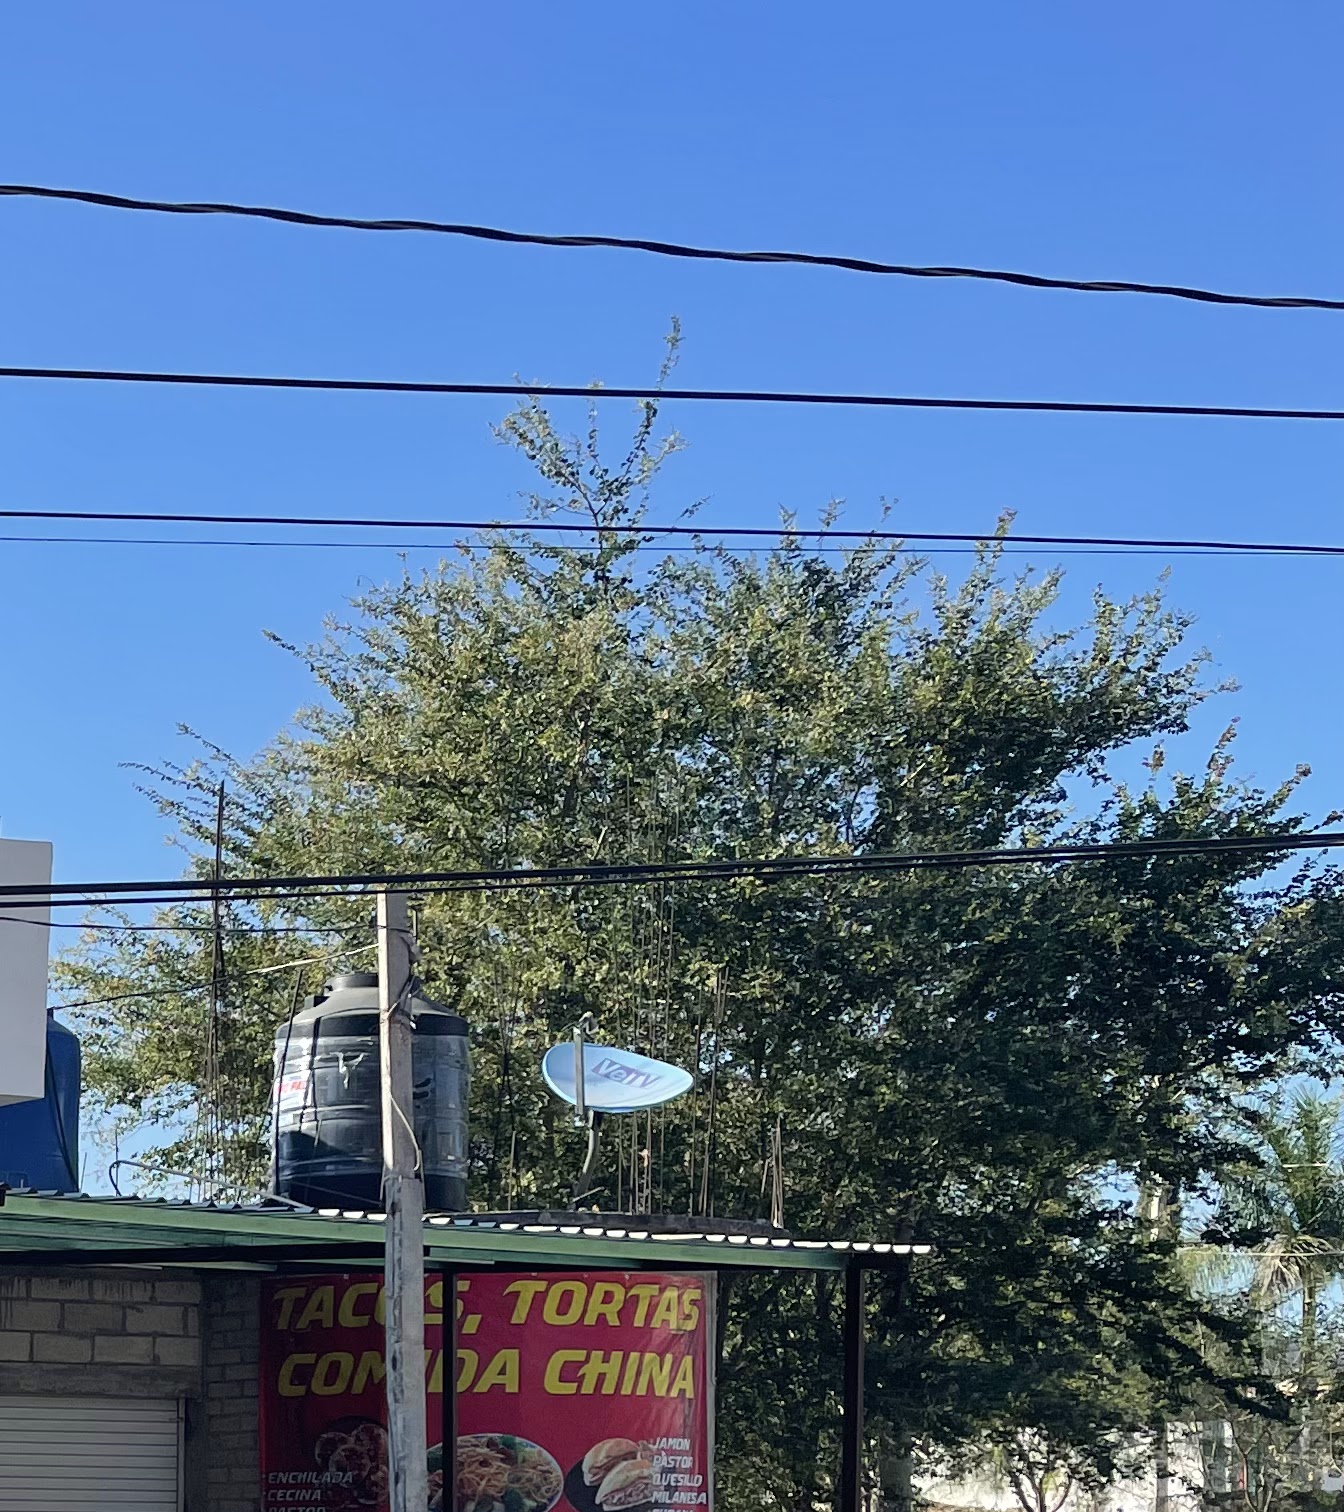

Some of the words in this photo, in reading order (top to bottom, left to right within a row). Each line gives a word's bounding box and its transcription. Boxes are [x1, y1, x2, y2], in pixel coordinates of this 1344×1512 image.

[273, 1280, 482, 1334] TACS,
[503, 1280, 701, 1332] TORTAS
[543, 1349, 695, 1399] CHINA
[268, 1471, 353, 1484] ENCHILADA
[267, 1489, 321, 1501] CECINA
